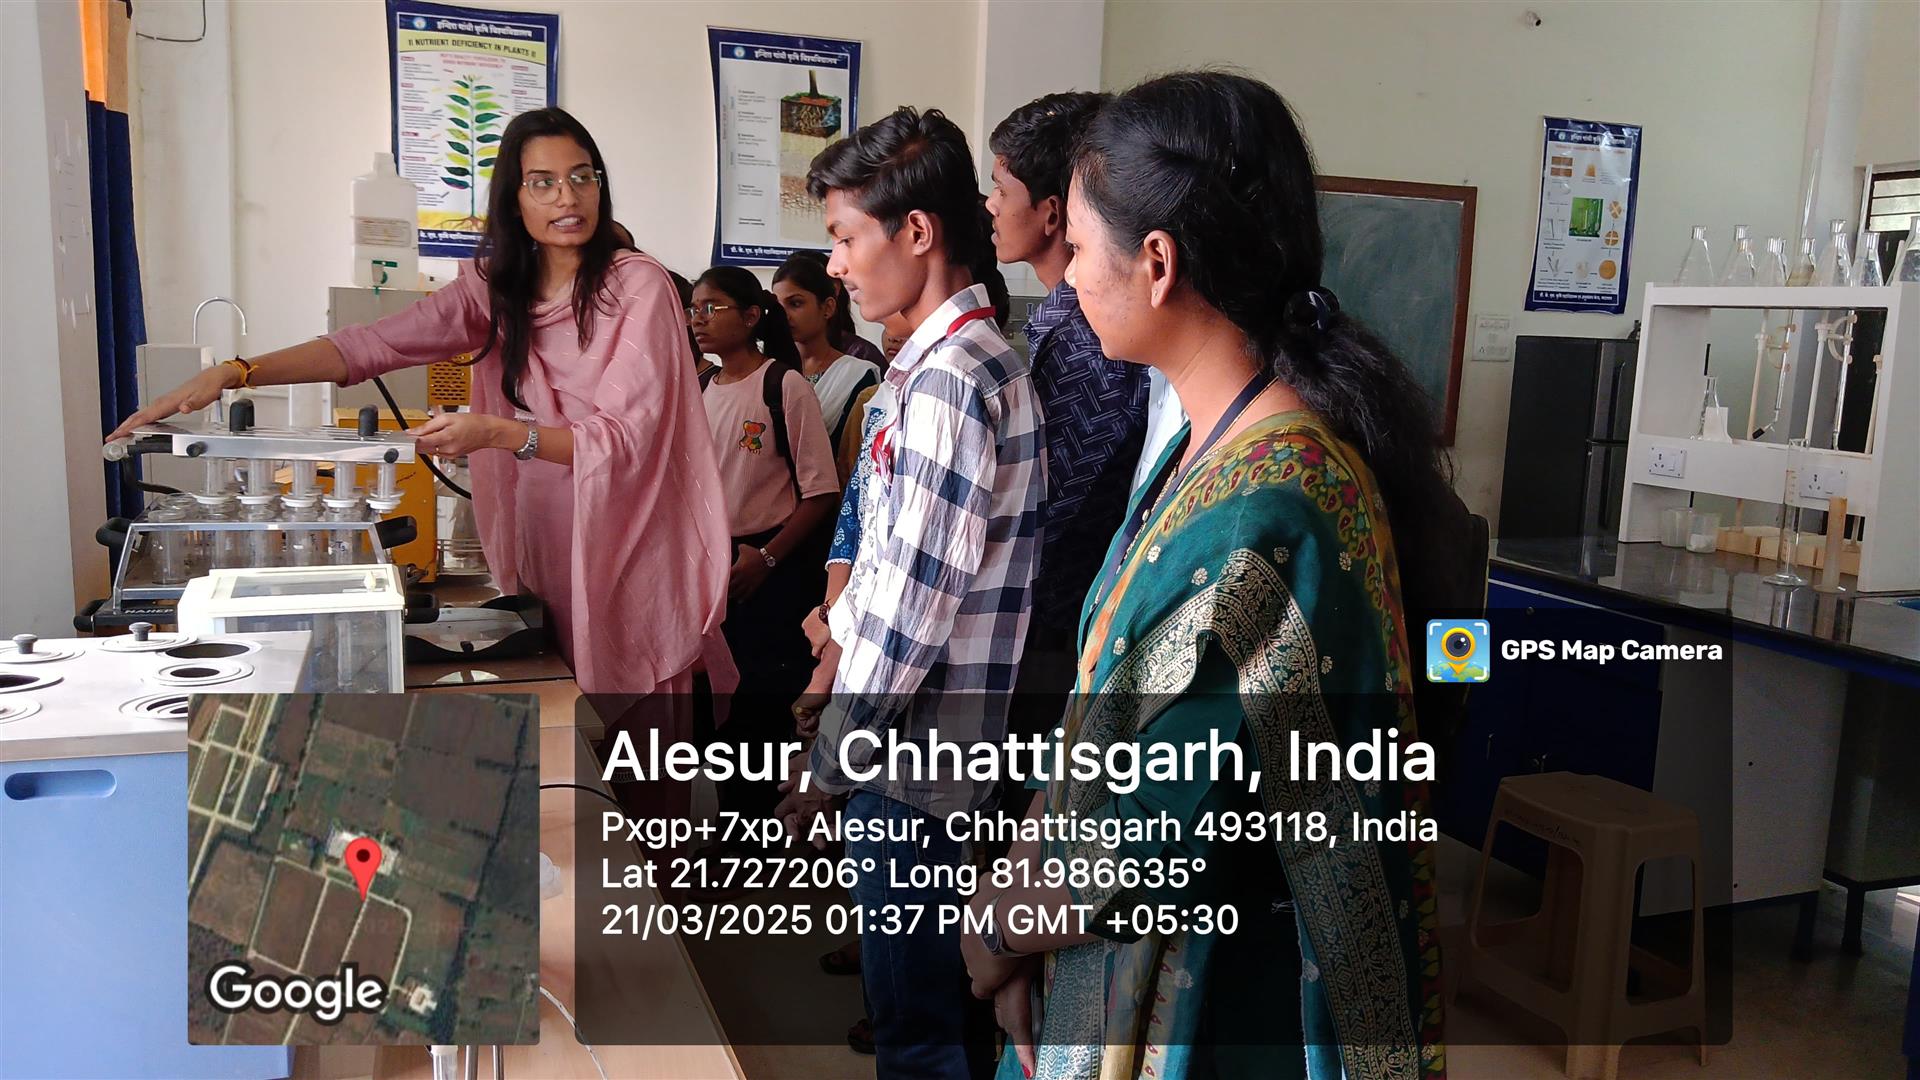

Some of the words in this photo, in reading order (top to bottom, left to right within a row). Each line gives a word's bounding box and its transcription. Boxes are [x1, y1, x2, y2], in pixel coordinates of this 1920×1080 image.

[415, 38, 449, 46] NUTRIENT
[451, 39, 492, 50] DEFICIENCY
[503, 46, 529, 56] PLANTS
